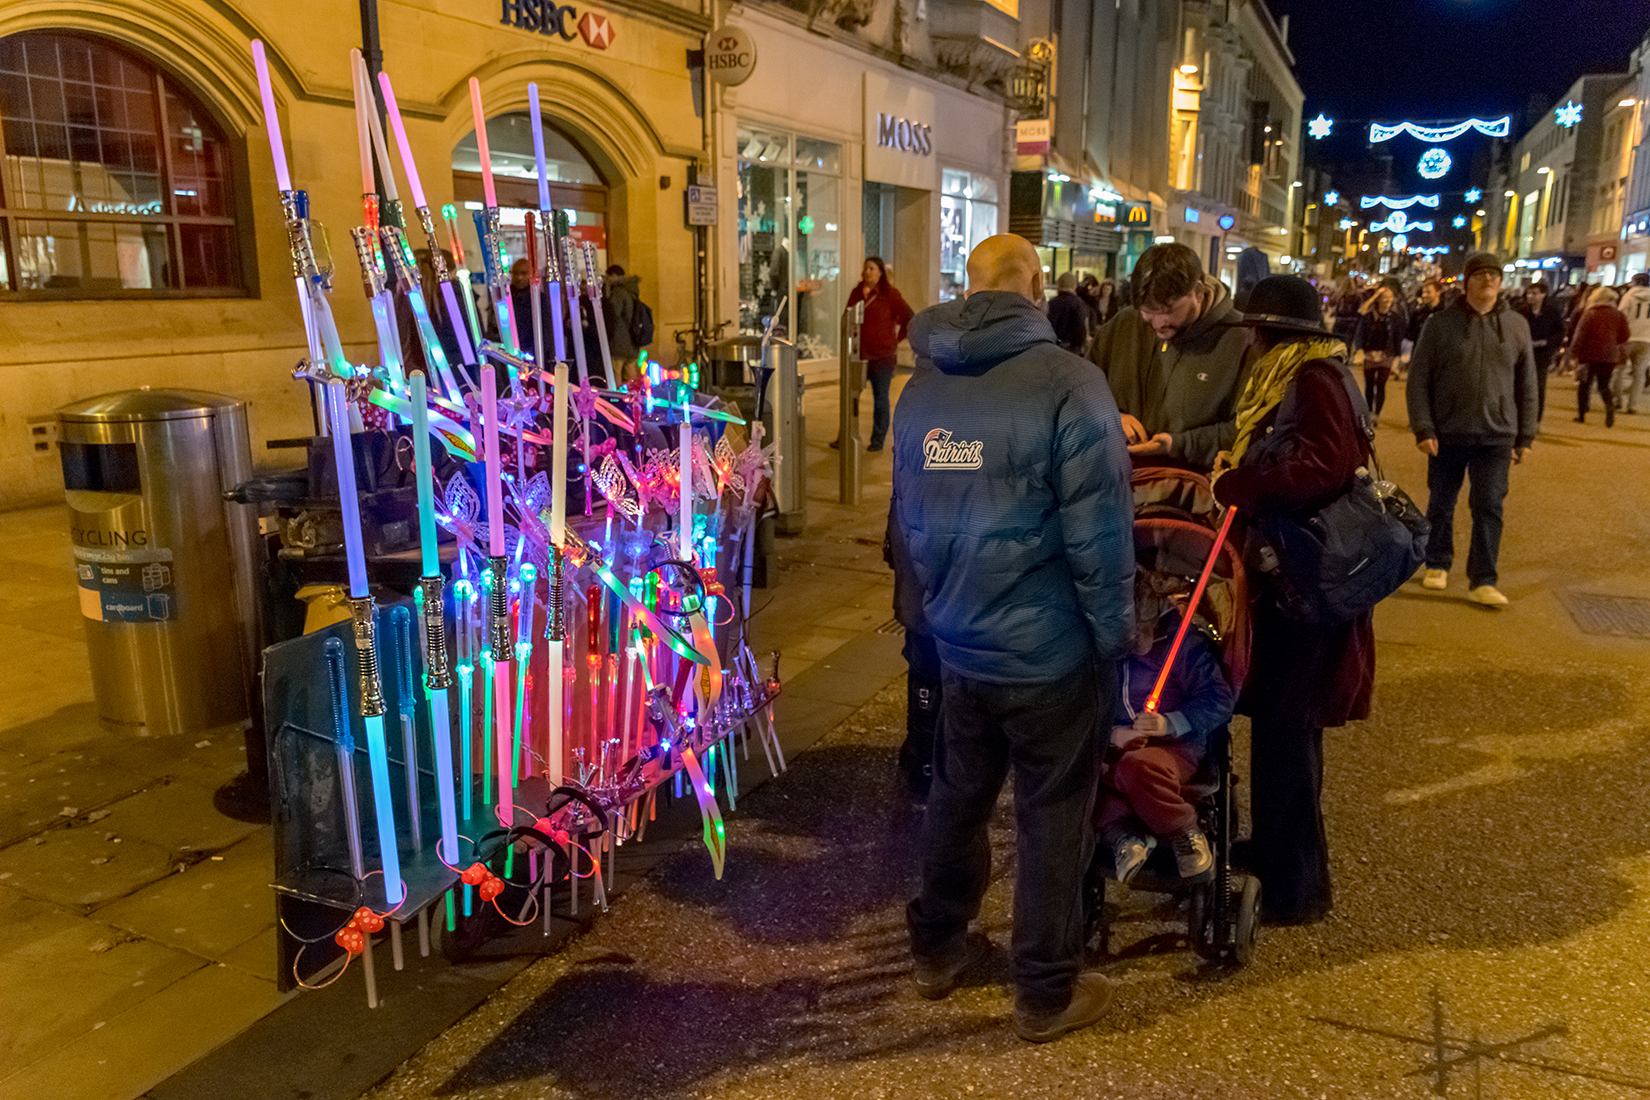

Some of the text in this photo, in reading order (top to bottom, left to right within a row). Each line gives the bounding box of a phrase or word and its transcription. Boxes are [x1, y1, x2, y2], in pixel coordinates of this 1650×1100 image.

[500, 0, 578, 42] HSBC
[709, 52, 749, 70] HSBC
[877, 113, 932, 157] MOSS
[1020, 127, 1047, 136] MOSS
[925, 440, 983, 468] Patriots
